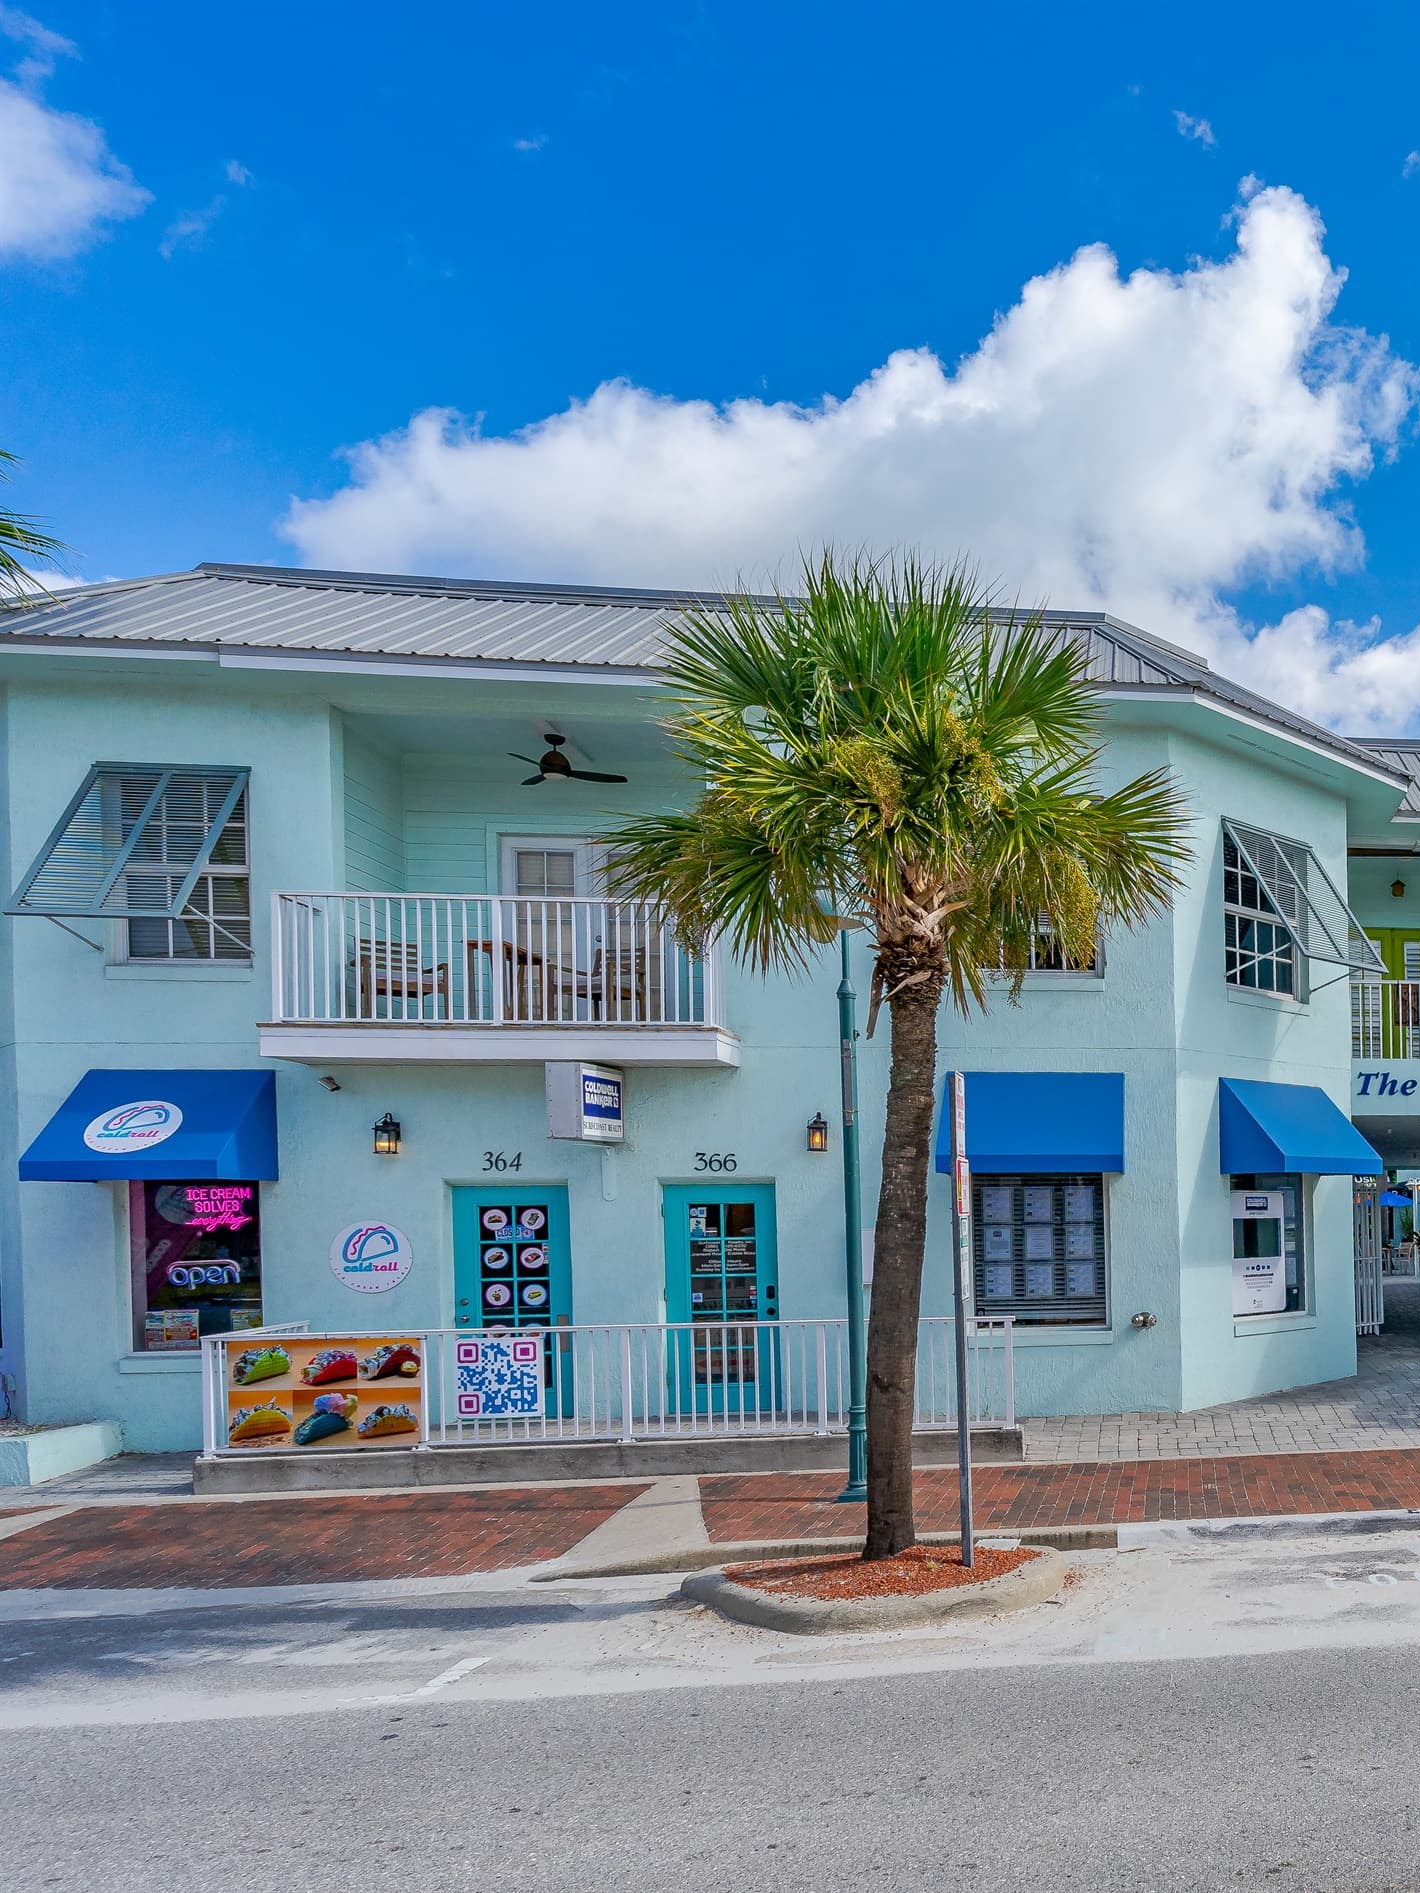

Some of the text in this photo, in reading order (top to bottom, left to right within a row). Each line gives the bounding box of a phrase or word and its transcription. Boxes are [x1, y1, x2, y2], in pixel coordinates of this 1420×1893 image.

[1356, 1071, 1417, 1096] The
[482, 1151, 522, 1172] 364
[694, 1152, 737, 1172] 366
[186, 1187, 251, 1200] ICE CREAM
[194, 1200, 240, 1212] SOLVES
[497, 1228, 521, 1238] CLOSD
[169, 1266, 240, 1290] open
